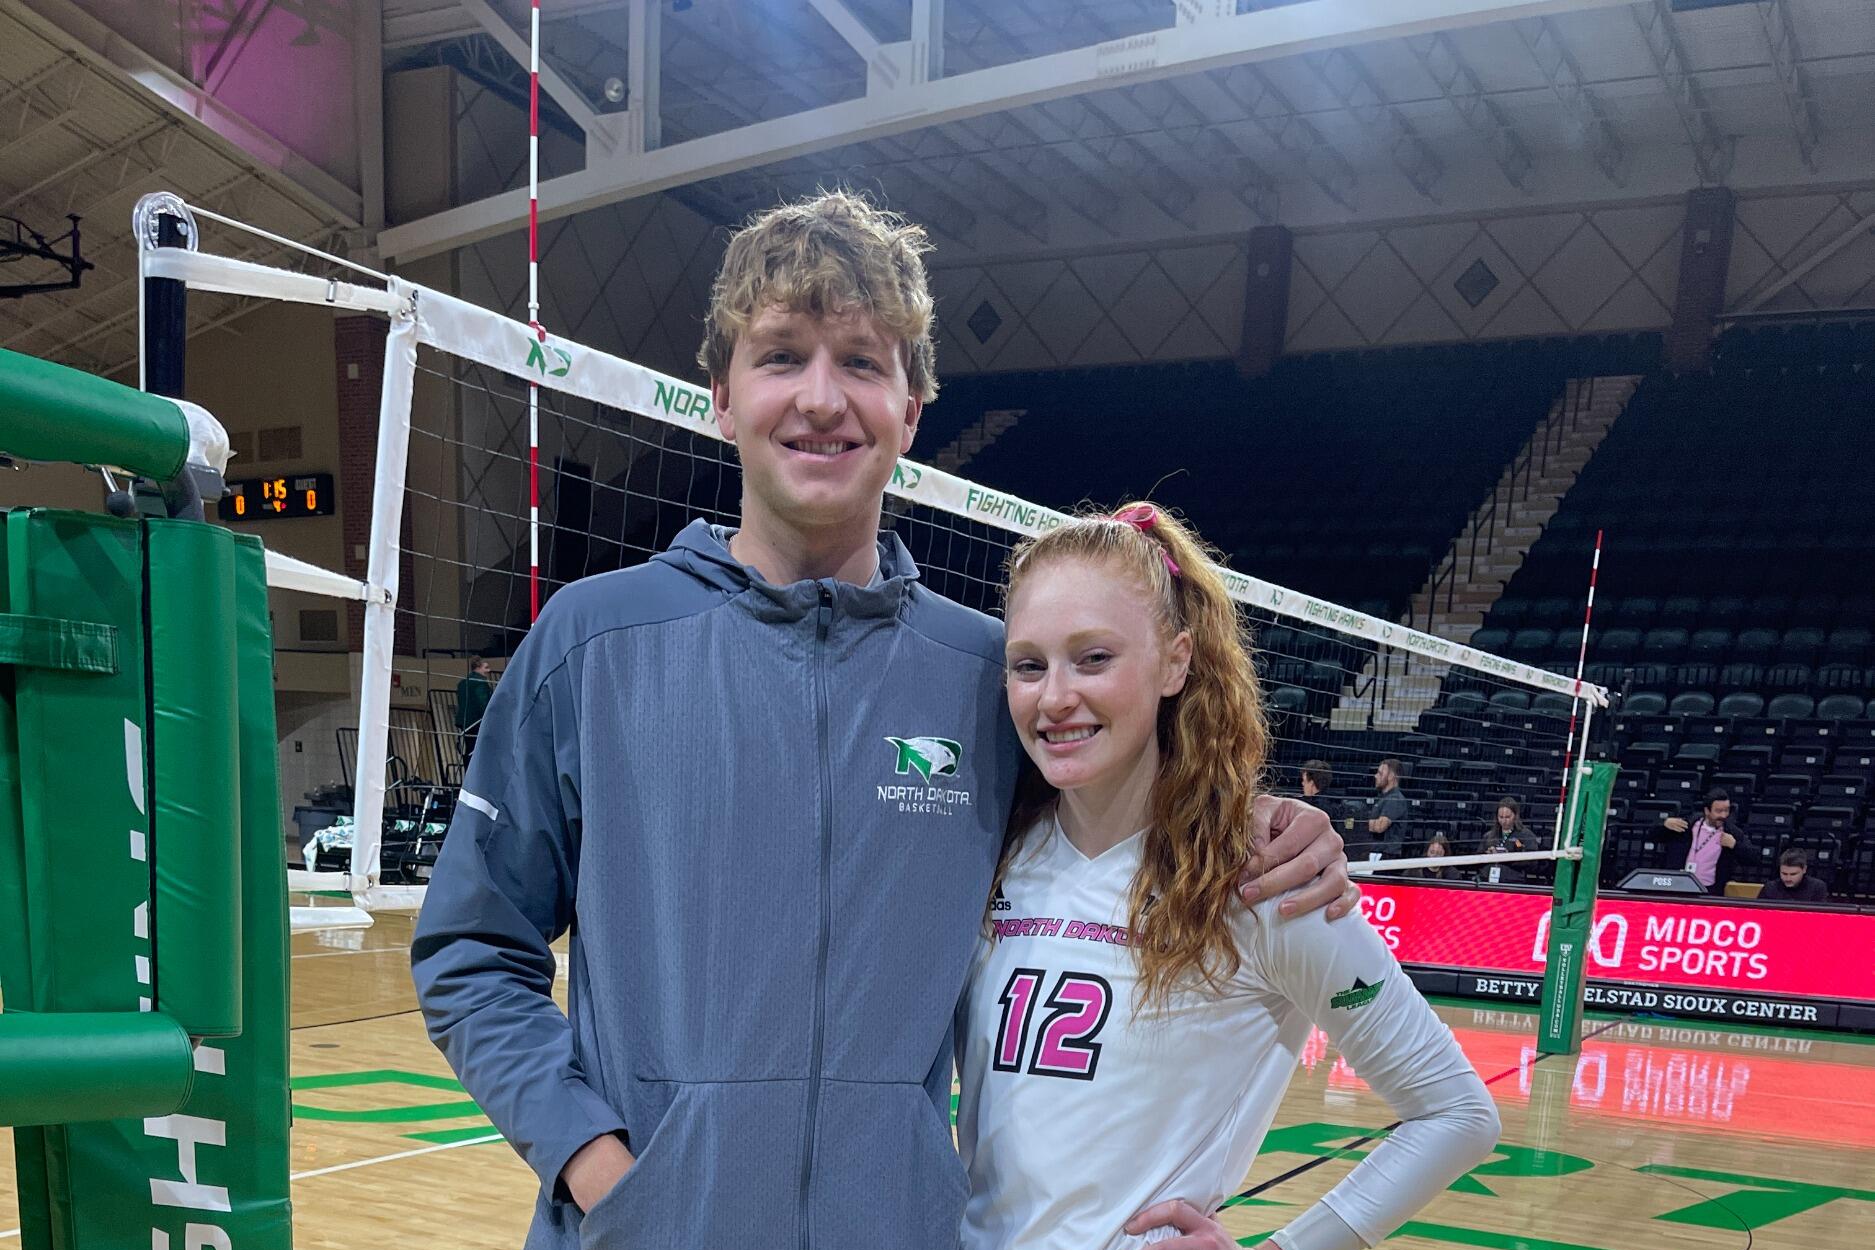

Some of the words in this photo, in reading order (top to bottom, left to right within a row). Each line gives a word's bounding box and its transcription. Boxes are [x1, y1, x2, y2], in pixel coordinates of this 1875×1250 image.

[653, 379, 717, 424] NOR
[966, 488, 1035, 526] FIGHTING
[877, 786, 925, 803] NORTH
[1652, 877, 1673, 887] POSS
[991, 899, 1012, 912] das
[992, 917, 1064, 944] NORTH
[1062, 919, 1130, 947] DAKO
[1645, 915, 1762, 949] MIDCO
[1638, 945, 1769, 980] SPORTS
[1475, 978, 1540, 997] BETTY
[1584, 987, 1658, 1008] ELSTAD
[1663, 994, 1728, 1014] SIOUX
[1732, 1000, 1818, 1022] CENTER
[993, 967, 1114, 1082] 12
